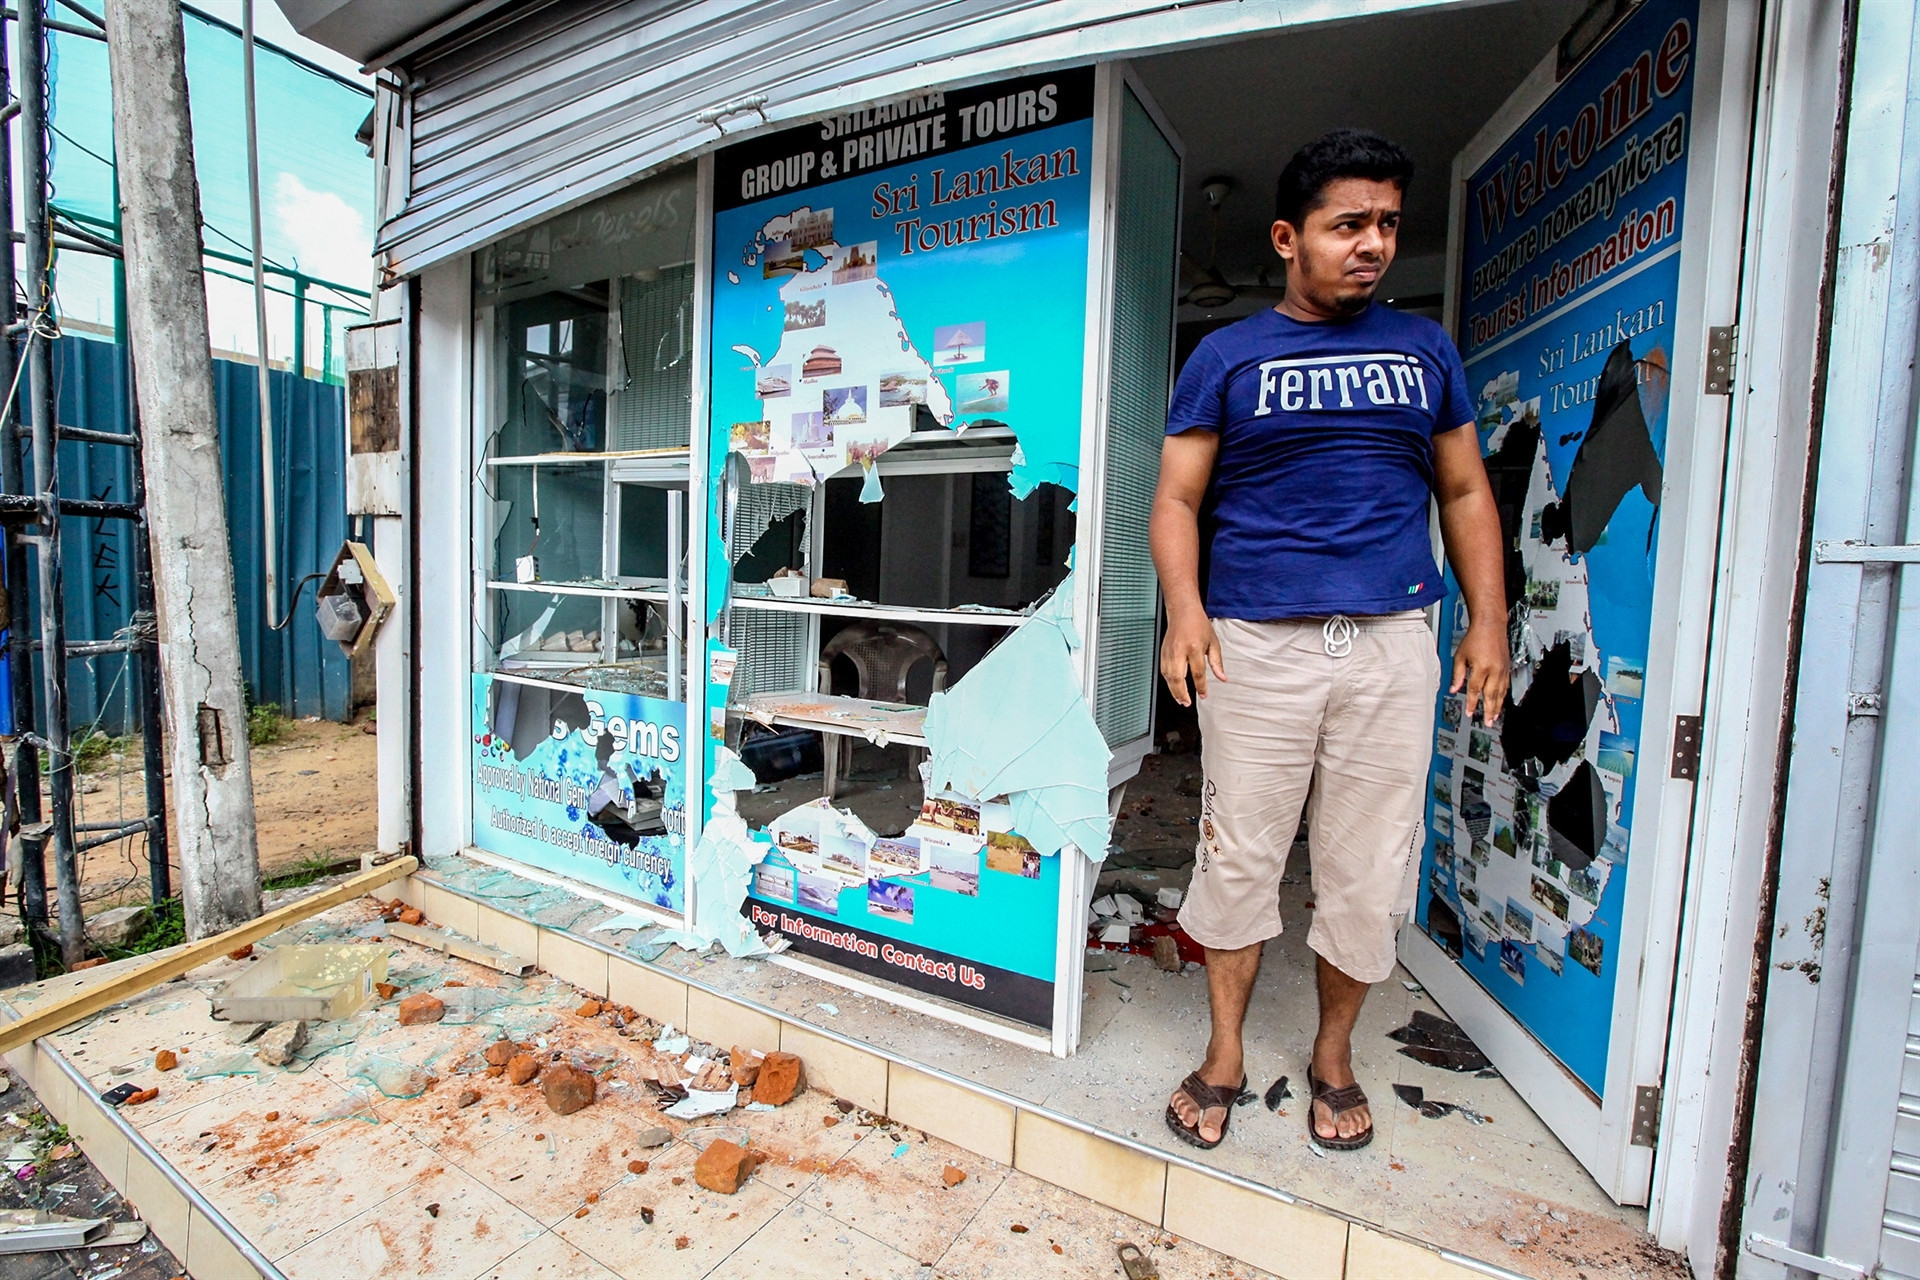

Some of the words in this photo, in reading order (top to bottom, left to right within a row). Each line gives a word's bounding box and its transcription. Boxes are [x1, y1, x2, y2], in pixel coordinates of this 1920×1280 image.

[741, 156, 814, 199] GROUP
[821, 155, 838, 179] &
[843, 114, 946, 172] PRIVATE
[959, 84, 1057, 143] TOURS
[1476, 17, 1691, 245] Welcome
[872, 174, 917, 219] Sri
[931, 146, 1079, 204] Lankan
[1472, 230, 1537, 301] входите
[1541, 112, 1686, 255] пожалуйста
[896, 199, 1058, 255] Tourism
[1470, 296, 1526, 351] Tourist
[1531, 197, 1676, 314] Information
[1538, 340, 1565, 379] Sri
[1571, 299, 1666, 368] Lankan
[1254, 353, 1429, 417] Ferrari
[1549, 357, 1653, 414] Tourm
[580, 700, 680, 763] Gems
[477, 756, 514, 793] Approved
[516, 765, 526, 802] by
[528, 768, 563, 804] National
[565, 775, 587, 810] Gem
[491, 805, 538, 840] Authorized
[539, 819, 549, 843] to
[551, 827, 583, 857] accept
[584, 831, 620, 867] foreign
[623, 847, 671, 883] currency
[751, 904, 778, 928] For
[780, 911, 878, 959] Information
[882, 944, 956, 981] Contact
[959, 964, 986, 991] Us
